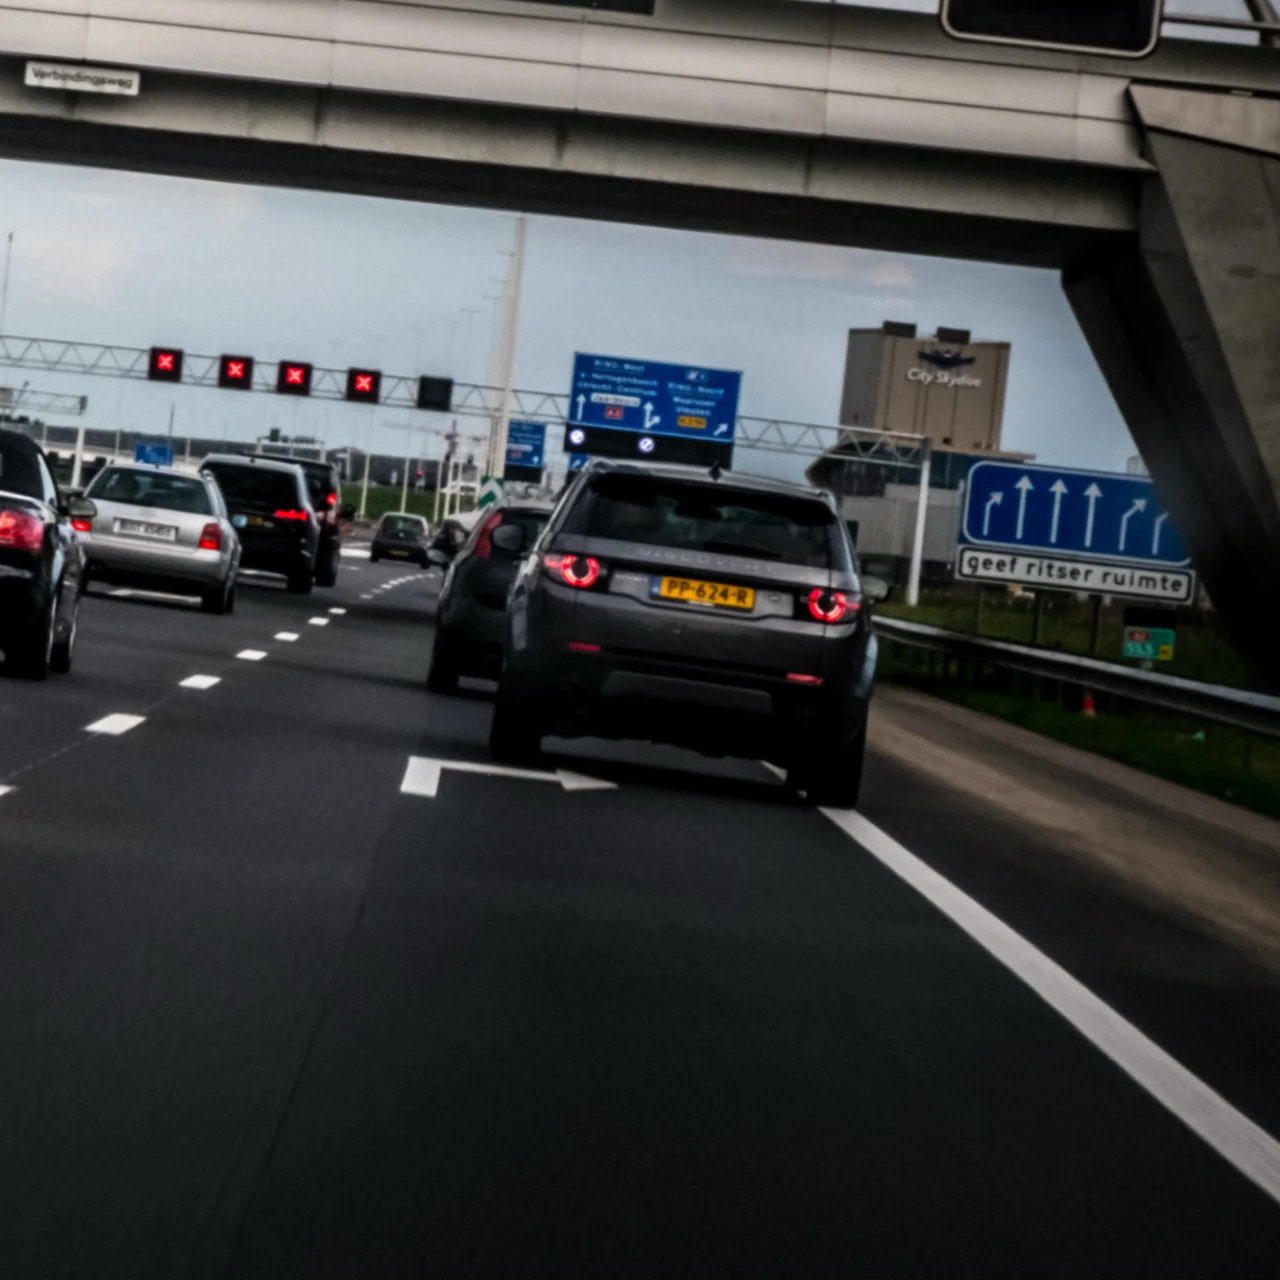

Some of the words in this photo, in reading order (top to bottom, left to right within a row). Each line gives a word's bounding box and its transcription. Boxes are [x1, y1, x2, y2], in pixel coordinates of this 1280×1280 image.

[907, 367, 934, 385] City
[936, 371, 982, 388] Skydive
[966, 556, 1017, 574] geef
[1026, 561, 1095, 582] ritser
[1102, 569, 1183, 593] ruimte
[666, 579, 749, 605] PP-624-R
